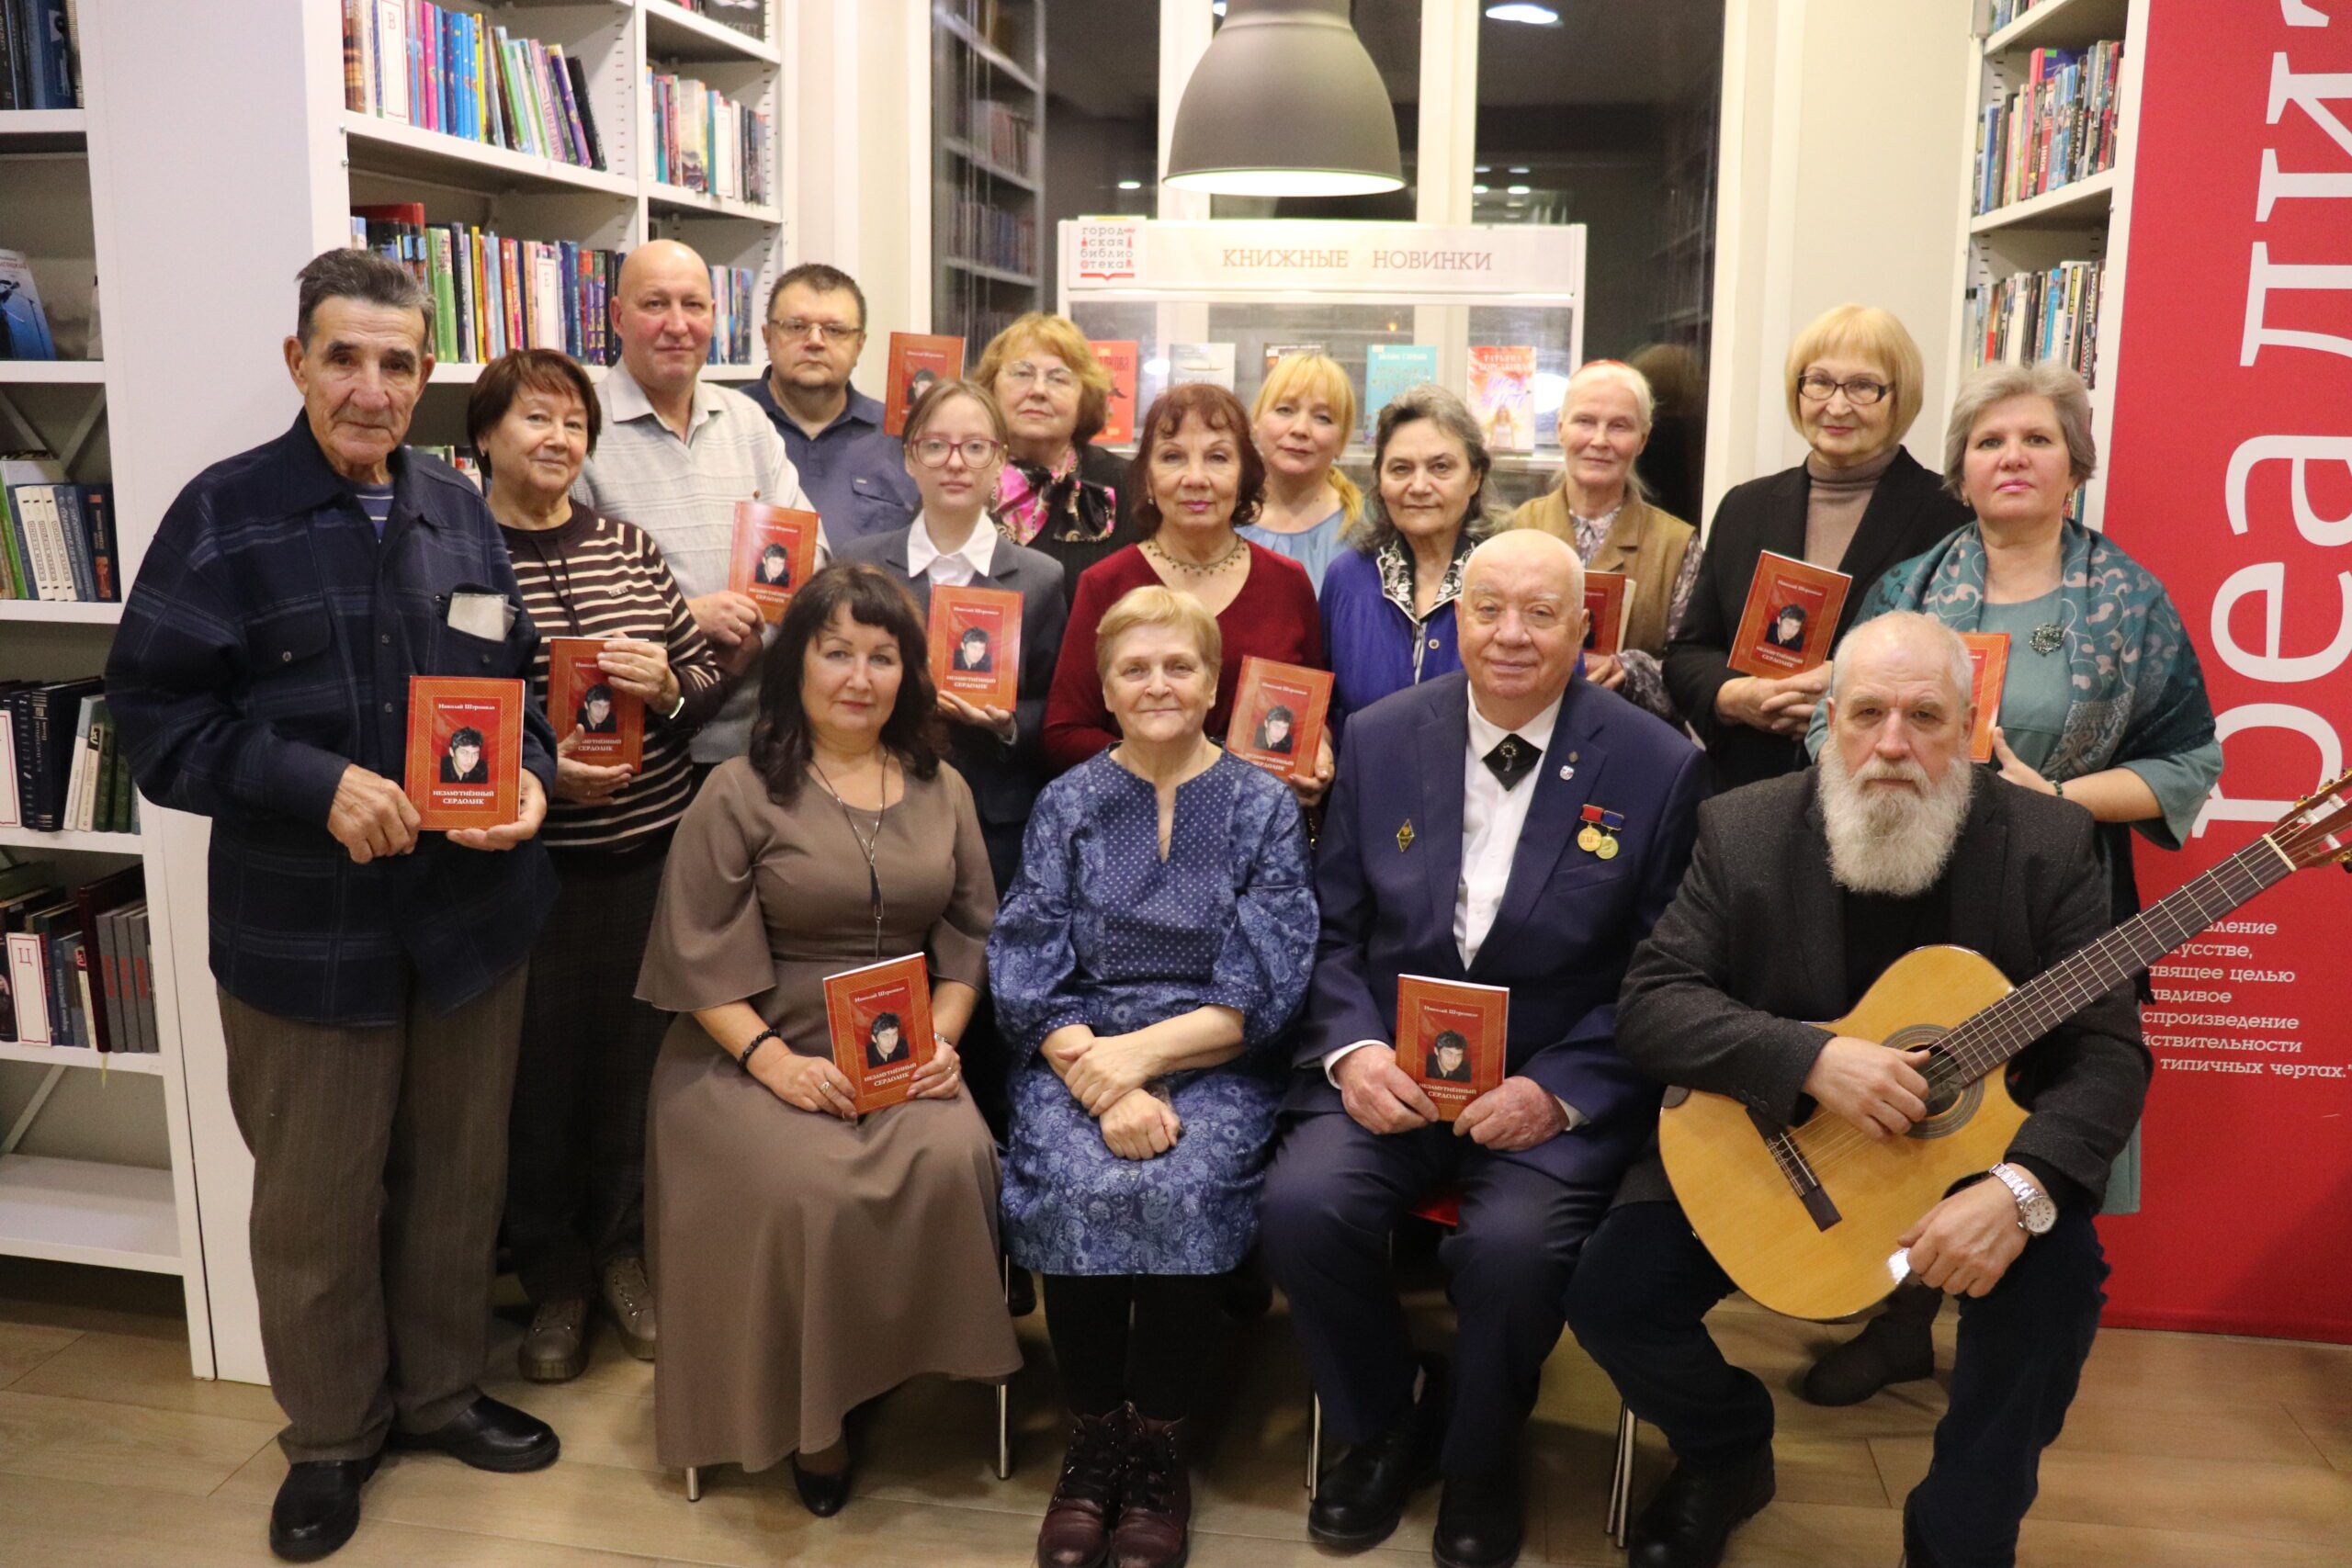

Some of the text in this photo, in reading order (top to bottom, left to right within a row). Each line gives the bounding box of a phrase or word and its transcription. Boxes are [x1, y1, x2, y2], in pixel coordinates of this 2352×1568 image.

[1081, 227, 1125, 237] город
[1088, 239, 1125, 247] ская
[1080, 248, 1134, 258] библио
[1222, 248, 1493, 271] КНИЖНЫЕ НОВИНКИ
[2191, 0, 2352, 838] реали
[17, 947, 32, 967] Ц
[2229, 969, 2296, 983] целью
[2142, 1011, 2300, 1030] спроизведение
[2160, 1058, 2264, 1075] типичных
[874, 1072, 910, 1087] СЕРДОЛИК
[1428, 1090, 1467, 1100] СЕРДОЛИК
